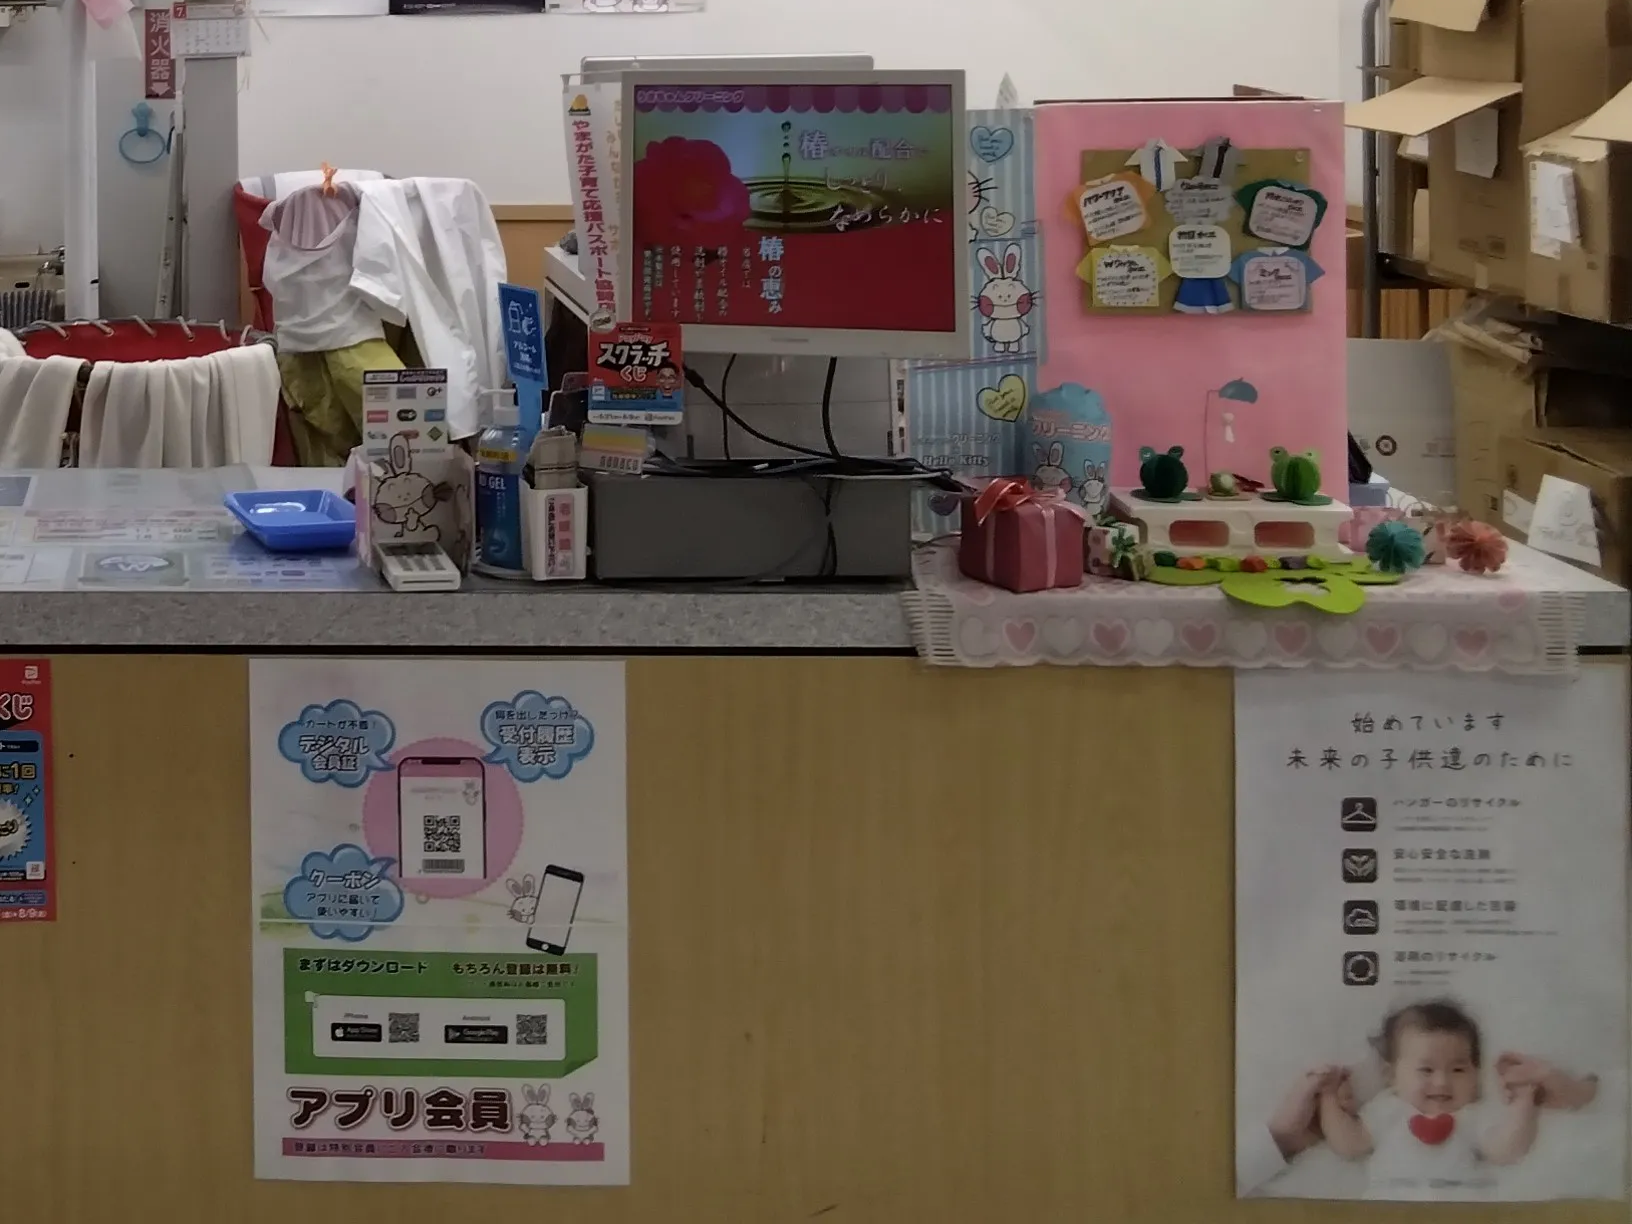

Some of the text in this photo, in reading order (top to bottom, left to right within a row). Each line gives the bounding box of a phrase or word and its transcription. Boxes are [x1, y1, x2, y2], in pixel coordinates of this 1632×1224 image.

[150, 12, 171, 80] 消火器
[758, 235, 785, 314] 椿の恵み
[596, 342, 670, 367] スクラッチ
[620, 365, 648, 382] くじ
[488, 475, 506, 489] GEL
[1350, 710, 1506, 735] 始めています
[299, 734, 369, 755] デジタル
[499, 724, 575, 745] 受付履歴
[518, 745, 556, 765] 表示
[1286, 743, 1574, 771] 未来の子供達のために
[309, 869, 382, 889] クーポン
[298, 958, 428, 974] まずはダウンロード
[288, 1087, 513, 1132] アプリ会員
